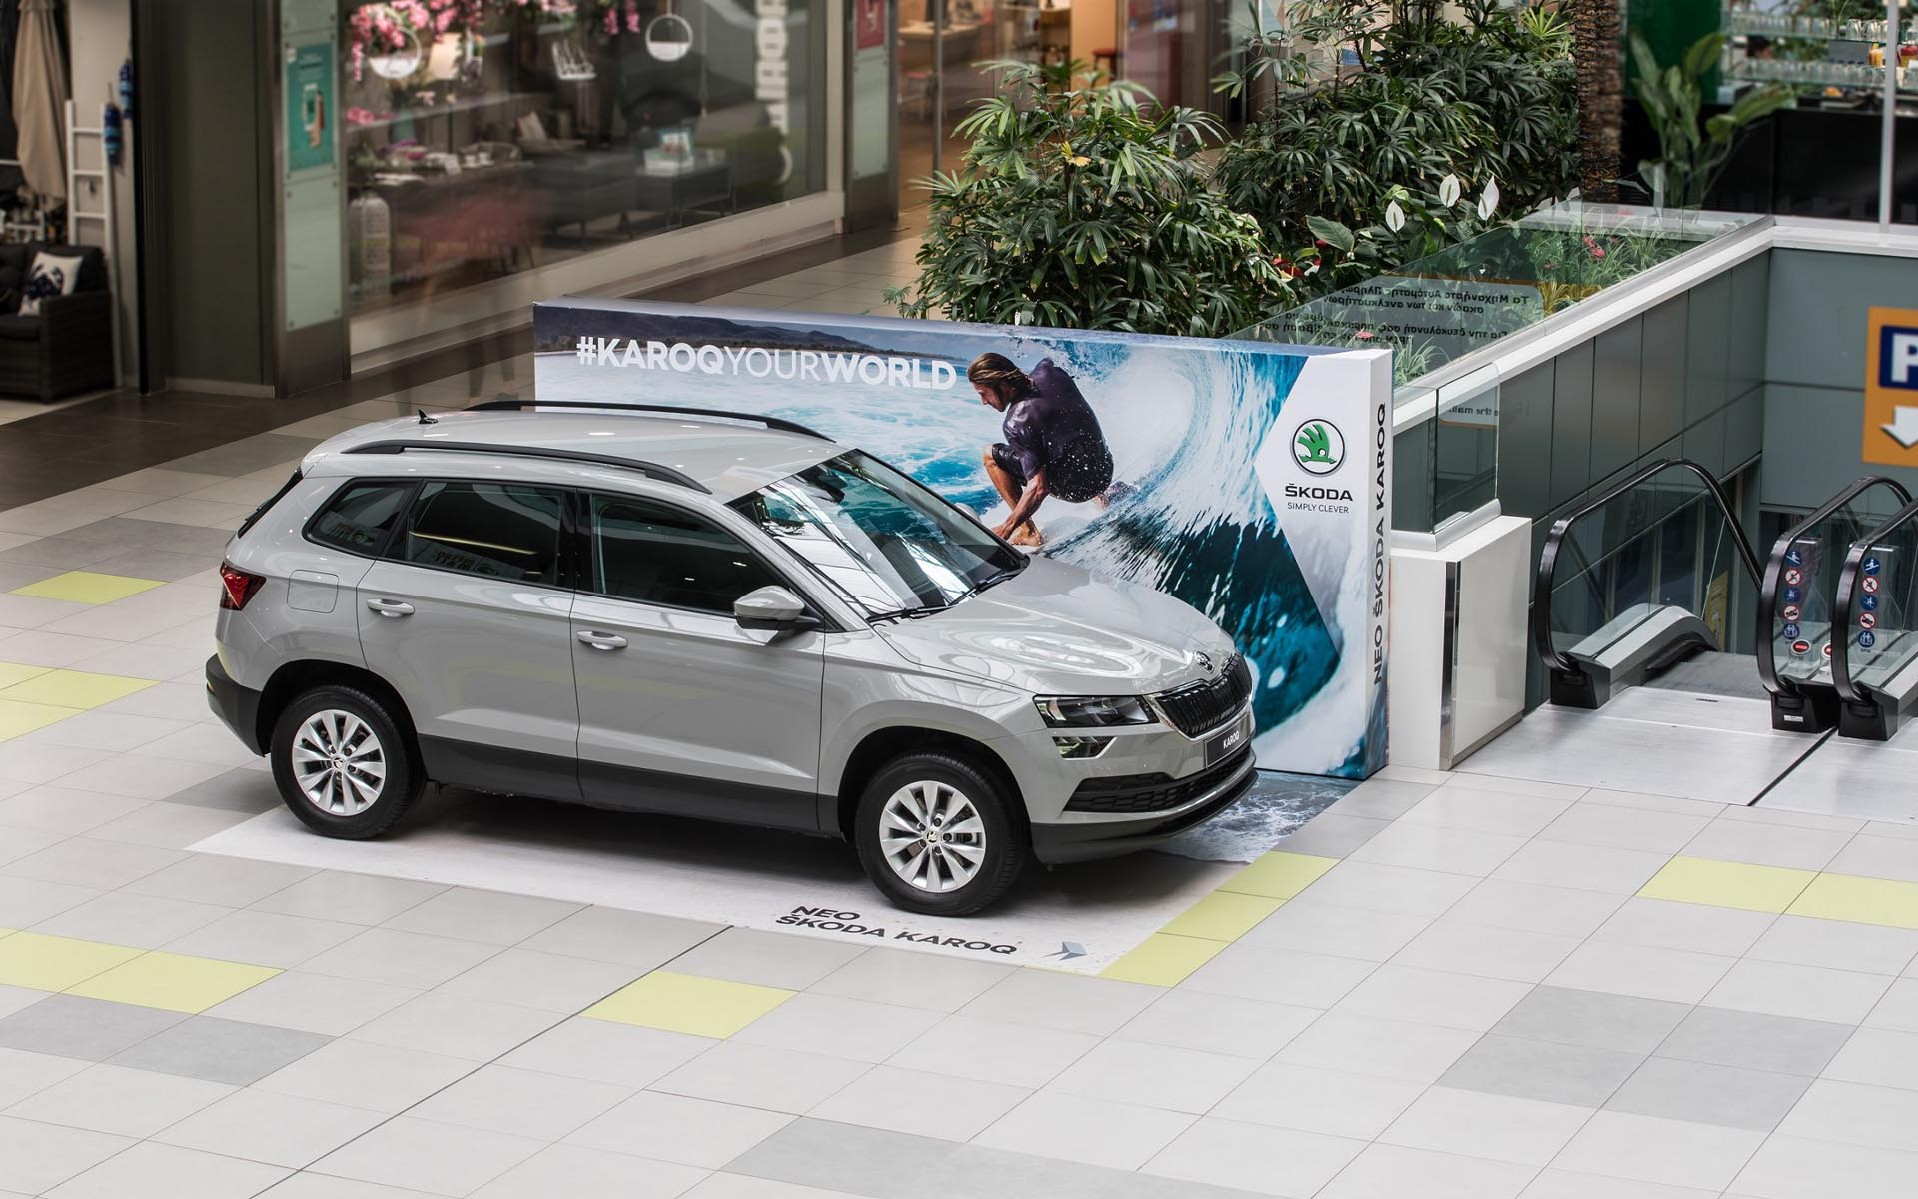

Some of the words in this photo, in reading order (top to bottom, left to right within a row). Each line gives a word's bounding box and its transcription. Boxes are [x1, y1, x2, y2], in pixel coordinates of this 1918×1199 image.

[576, 336, 957, 391] #KAROQYOURWORLD
[1891, 332, 1918, 383] P
[1376, 402, 1386, 511] KAROQ
[1285, 483, 1354, 501] ŠKODA
[1287, 502, 1318, 512] SIMPLY
[1318, 504, 1349, 514] CLEVER
[1372, 516, 1385, 618] ŠKODA
[1373, 625, 1384, 685] NEO
[1223, 730, 1240, 749] KAROQ
[775, 915, 885, 938] ŠKODA
[894, 931, 1017, 955] KAROQ
[791, 905, 861, 920] NEO
